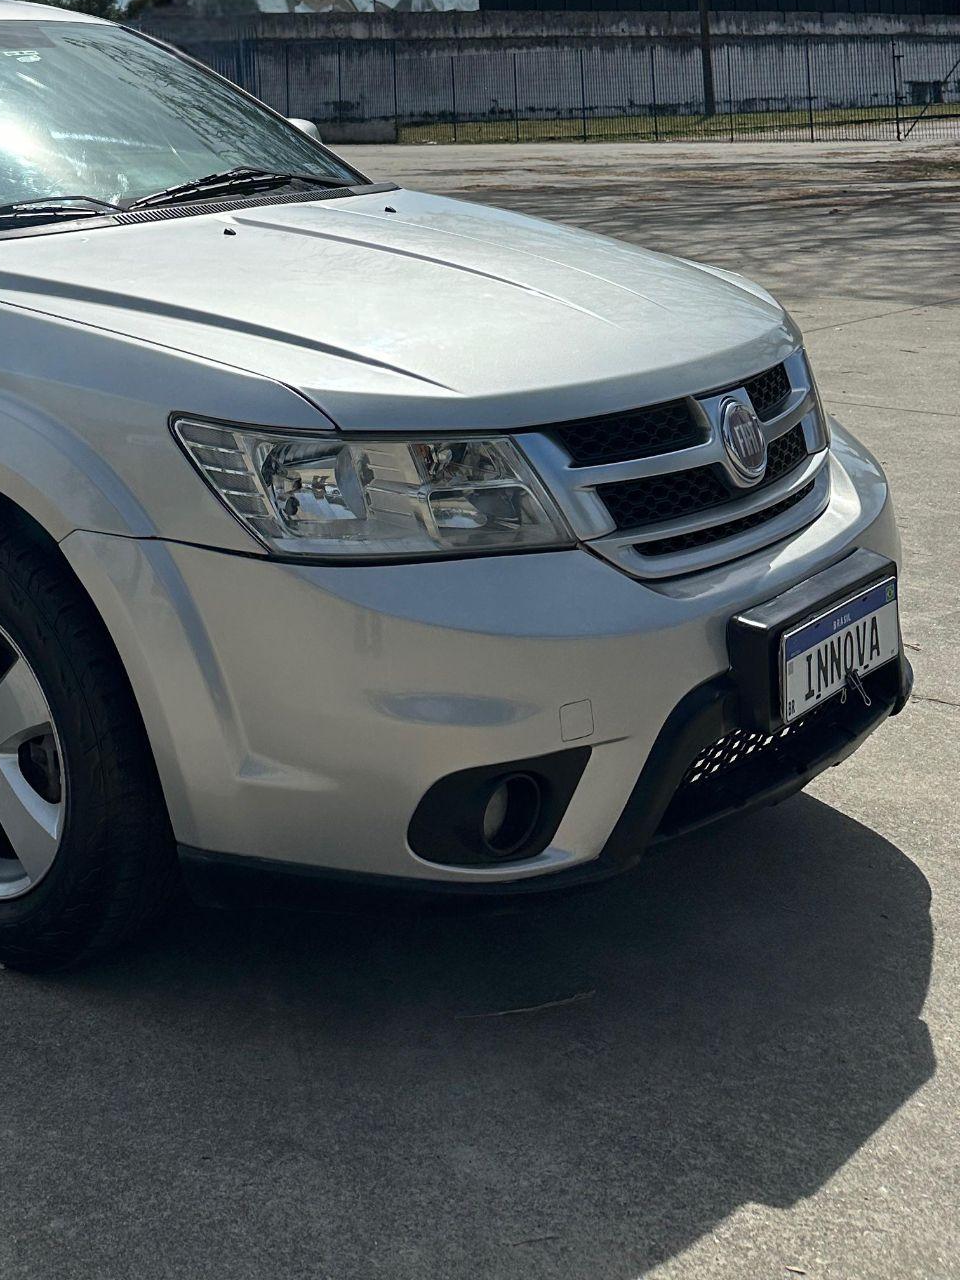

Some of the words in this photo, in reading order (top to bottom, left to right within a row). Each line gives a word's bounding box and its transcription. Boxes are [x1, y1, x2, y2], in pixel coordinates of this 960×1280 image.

[734, 421, 761, 458] FIAT
[833, 613, 851, 630] BRASIL
[805, 616, 880, 701] INNOVA
[788, 699, 796, 716] BR
